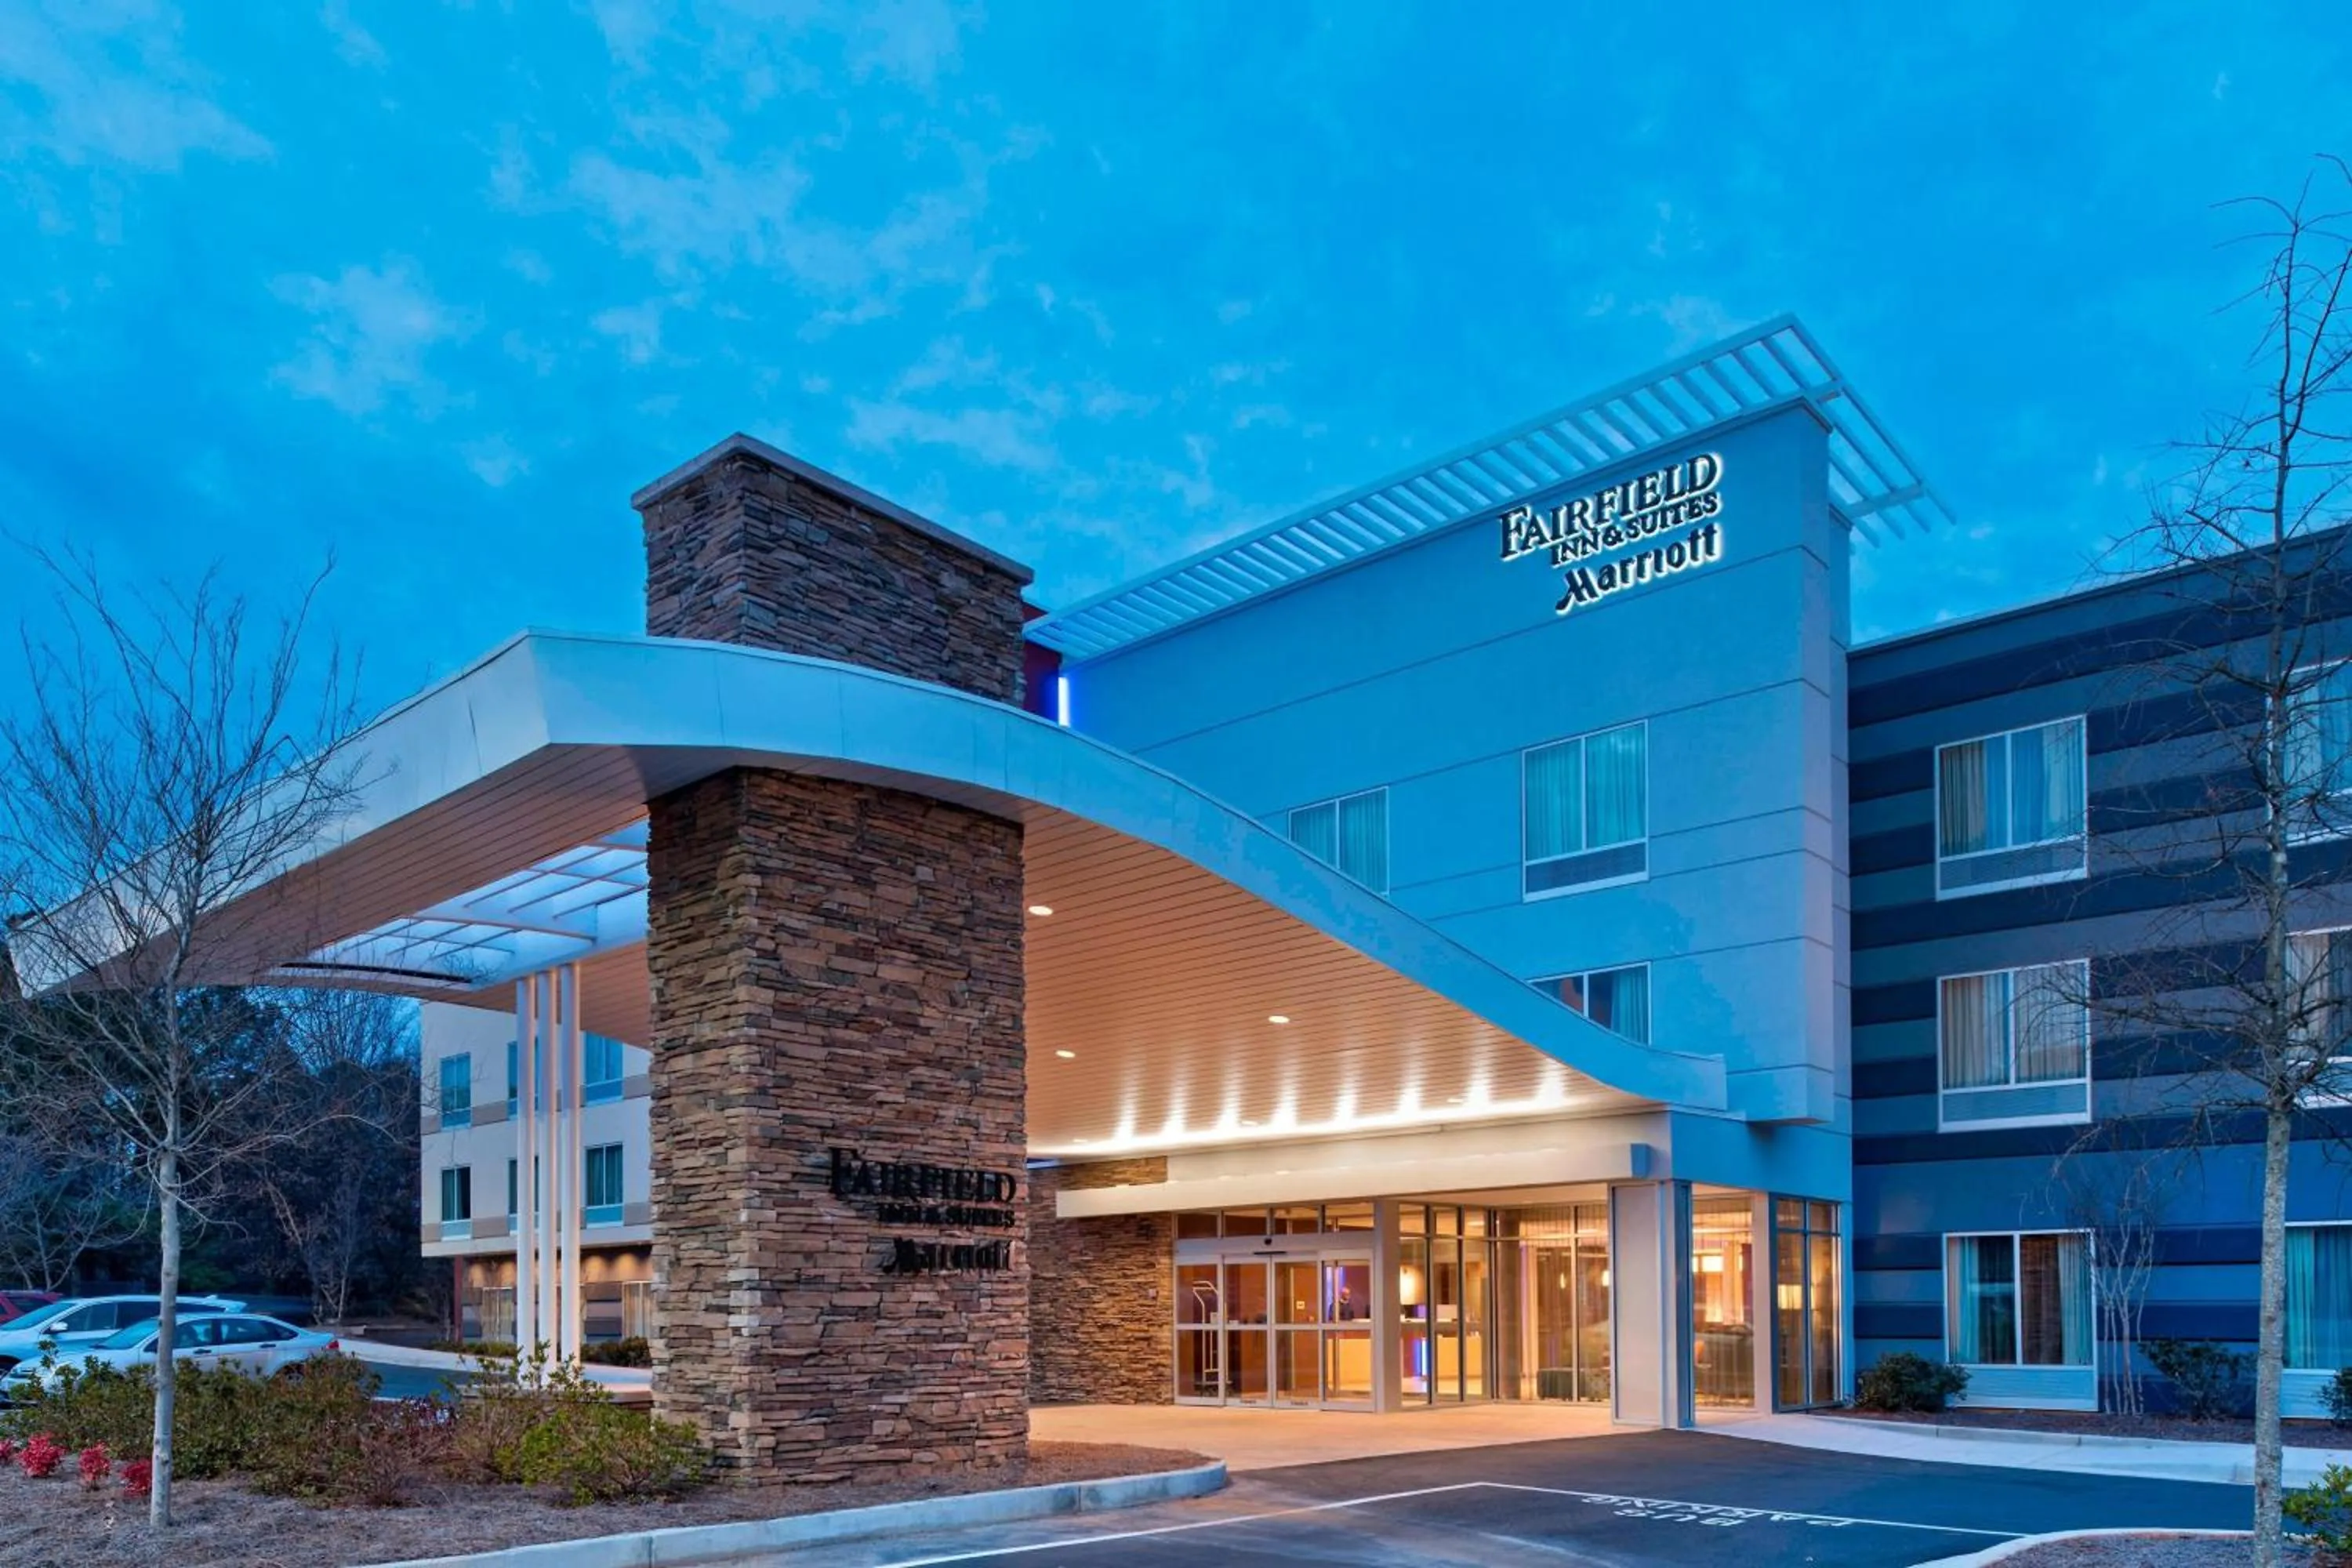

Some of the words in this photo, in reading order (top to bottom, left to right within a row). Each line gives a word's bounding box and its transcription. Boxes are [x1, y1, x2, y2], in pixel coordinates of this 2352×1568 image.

[1498, 454, 1719, 558] FAIRFIELD
[1552, 528, 1600, 565] INN
[1602, 524, 1624, 547] &
[1625, 491, 1720, 539] SUITES
[1555, 523, 1721, 612] Marriott
